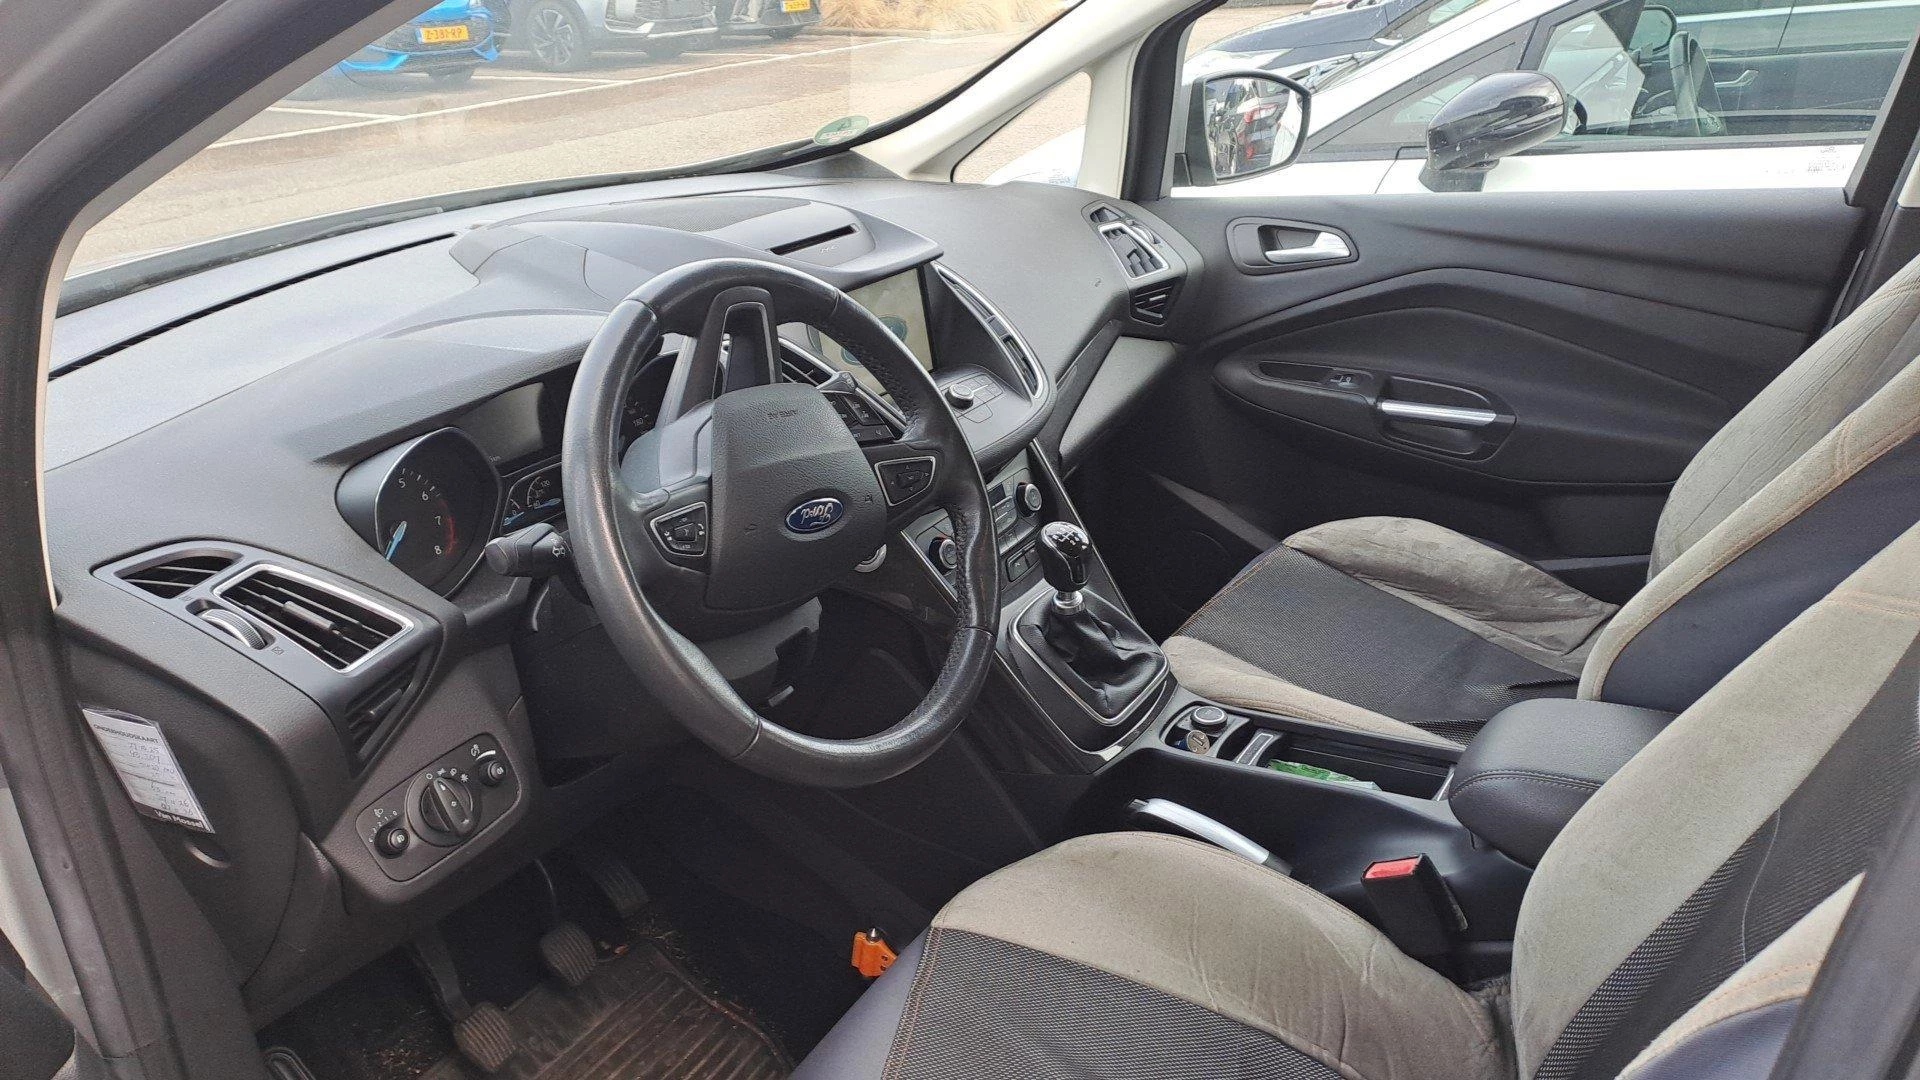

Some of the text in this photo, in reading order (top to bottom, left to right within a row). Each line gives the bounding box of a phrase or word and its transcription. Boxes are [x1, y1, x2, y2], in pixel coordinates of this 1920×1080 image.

[398, 477, 406, 488] 5
[421, 490, 429, 501] 6
[800, 502, 834, 527] Ford
[434, 515, 442, 526] 7
[434, 545, 442, 555] 8
